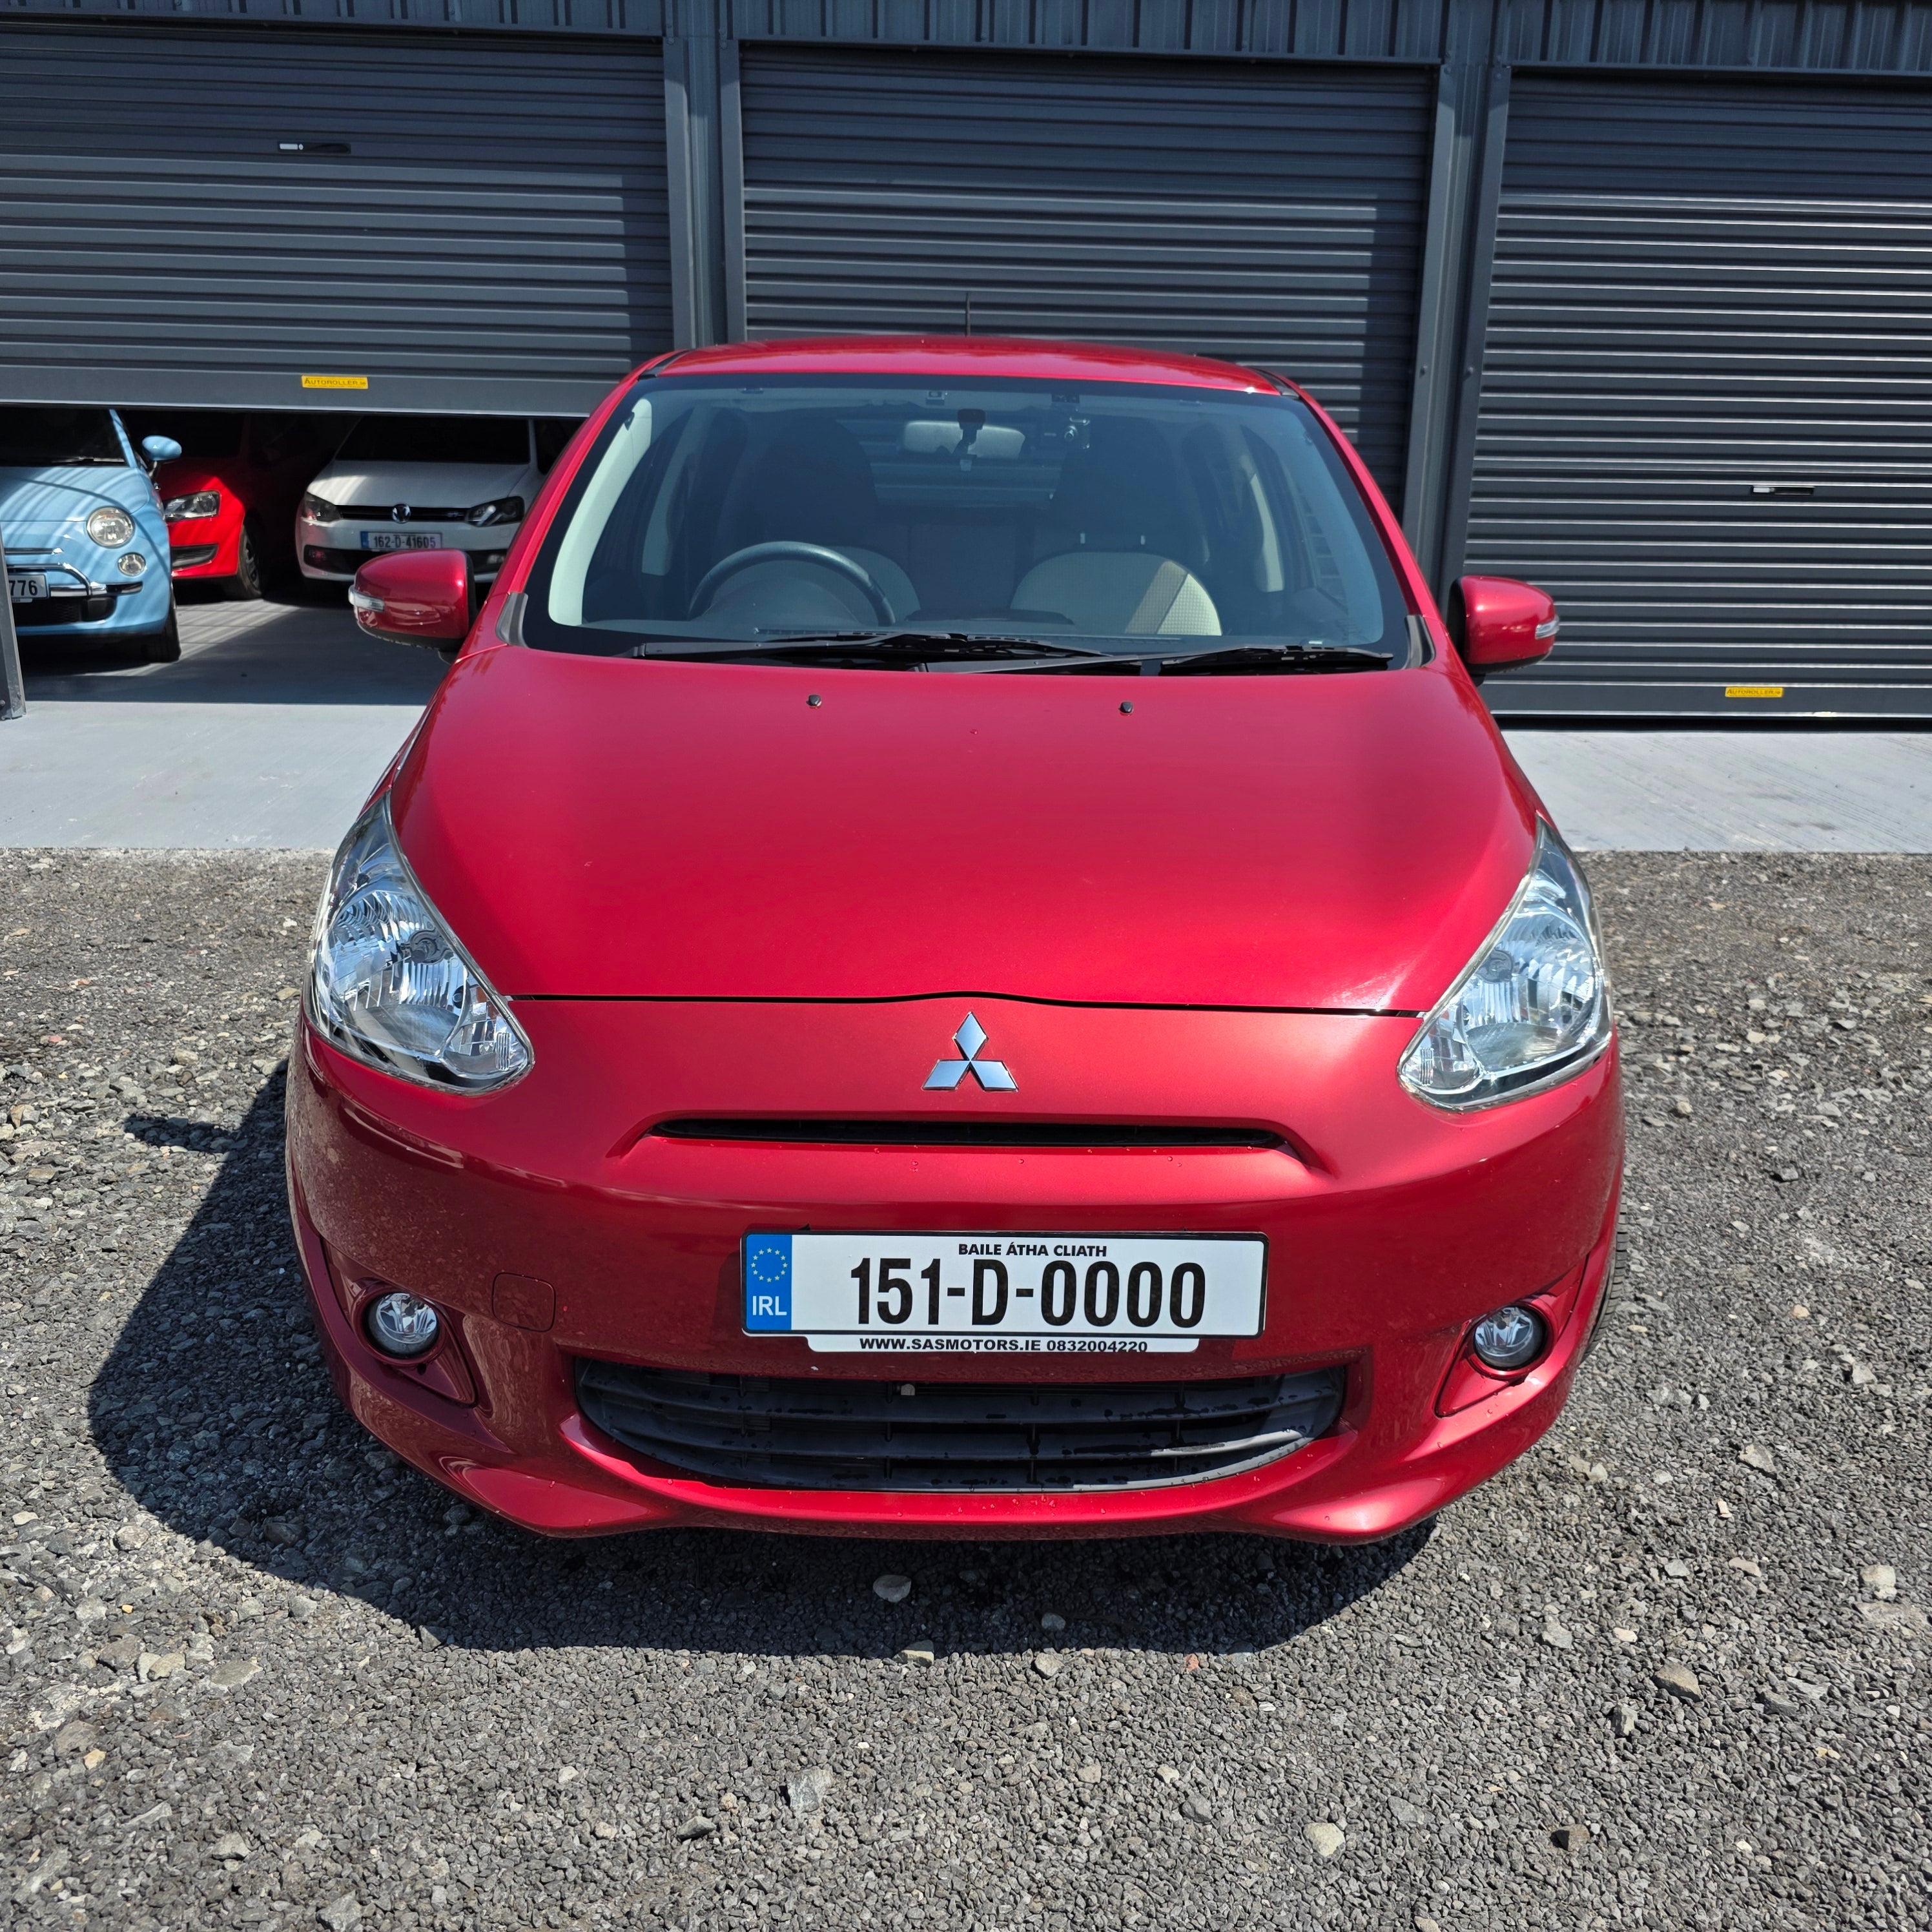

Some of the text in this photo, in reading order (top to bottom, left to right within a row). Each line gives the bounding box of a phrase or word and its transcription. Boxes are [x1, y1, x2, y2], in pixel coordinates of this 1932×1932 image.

[373, 535, 436, 548] 162-D-41605
[8, 580, 37, 595] 776
[958, 1242, 1107, 1257] BAILE ÁTHA CLIATH
[850, 1257, 1206, 1327] 151-D-0000
[752, 1296, 787, 1315] IRL
[859, 1338, 1147, 1353] WWW.SASMOTORS.IE 0832004220
